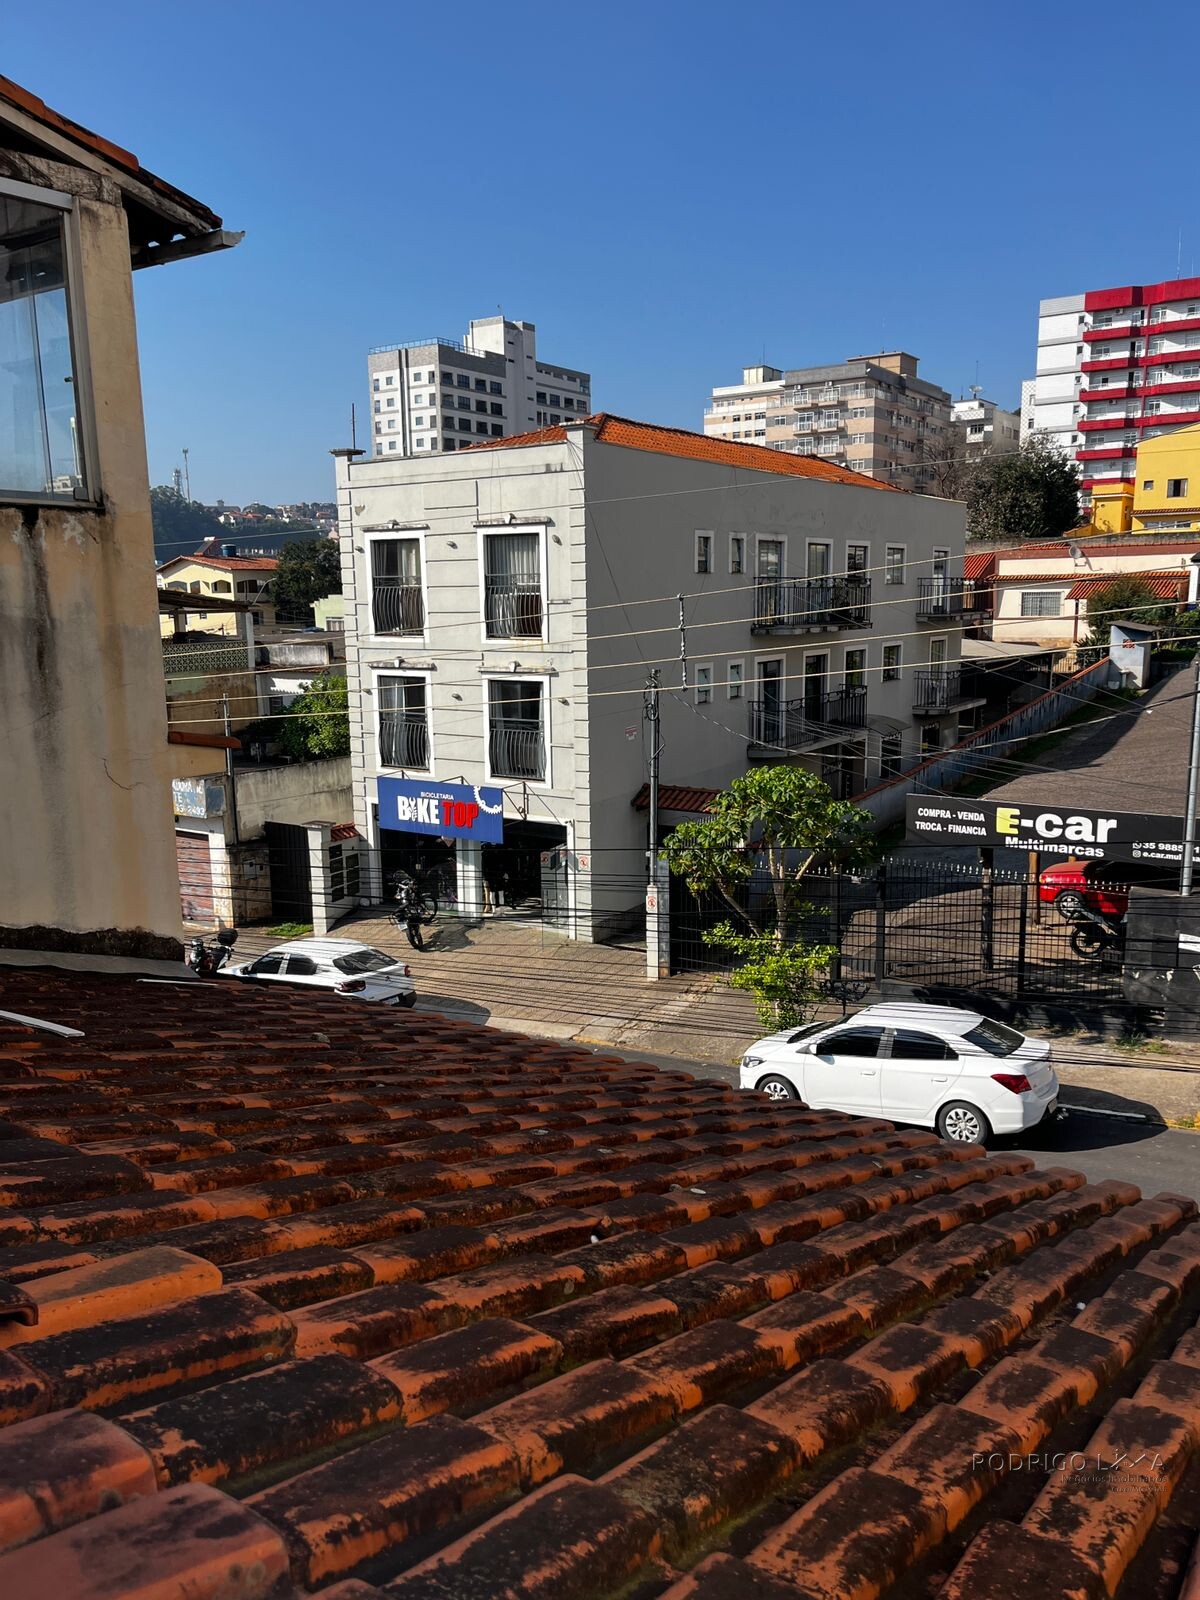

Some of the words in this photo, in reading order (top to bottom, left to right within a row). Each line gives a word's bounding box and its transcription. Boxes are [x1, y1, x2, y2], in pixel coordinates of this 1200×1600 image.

[420, 791, 454, 800] BICICLETARIA
[397, 795, 440, 825] BIKE
[442, 801, 479, 828] TOP
[918, 807, 951, 819] COMPRA
[957, 811, 985, 822] VENDA
[915, 821, 942, 832] TROCA
[948, 824, 987, 836] FINANCIA
[996, 807, 1118, 843] E-car
[1005, 836, 1105, 858] Multimarcas
[1142, 842, 1156, 850] 35
[1158, 843, 1186, 852] 9885
